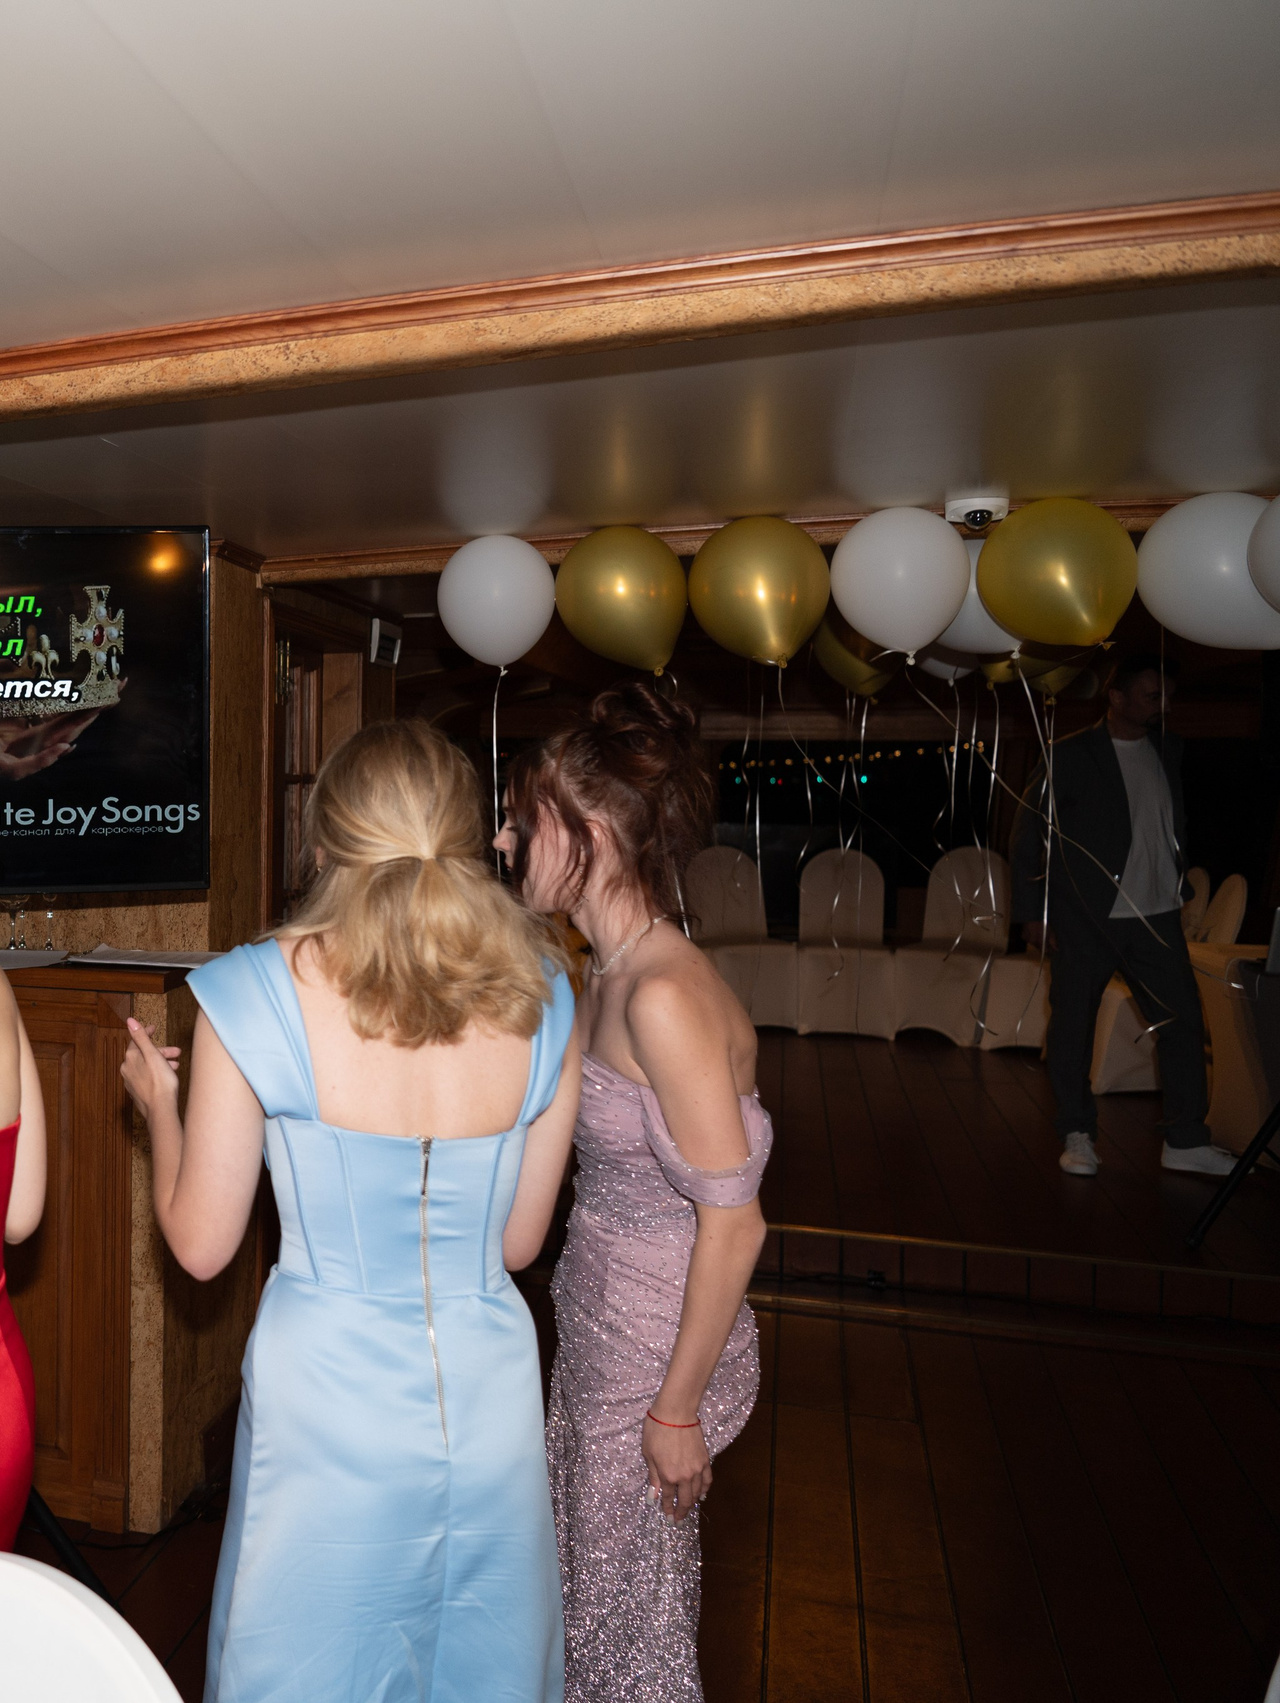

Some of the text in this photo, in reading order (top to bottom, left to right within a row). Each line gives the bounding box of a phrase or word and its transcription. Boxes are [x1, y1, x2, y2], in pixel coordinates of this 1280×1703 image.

[42, 798, 97, 836] Joy
[101, 796, 201, 834] Songs
[54, 827, 76, 836] для
[91, 826, 164, 837] караокеров
